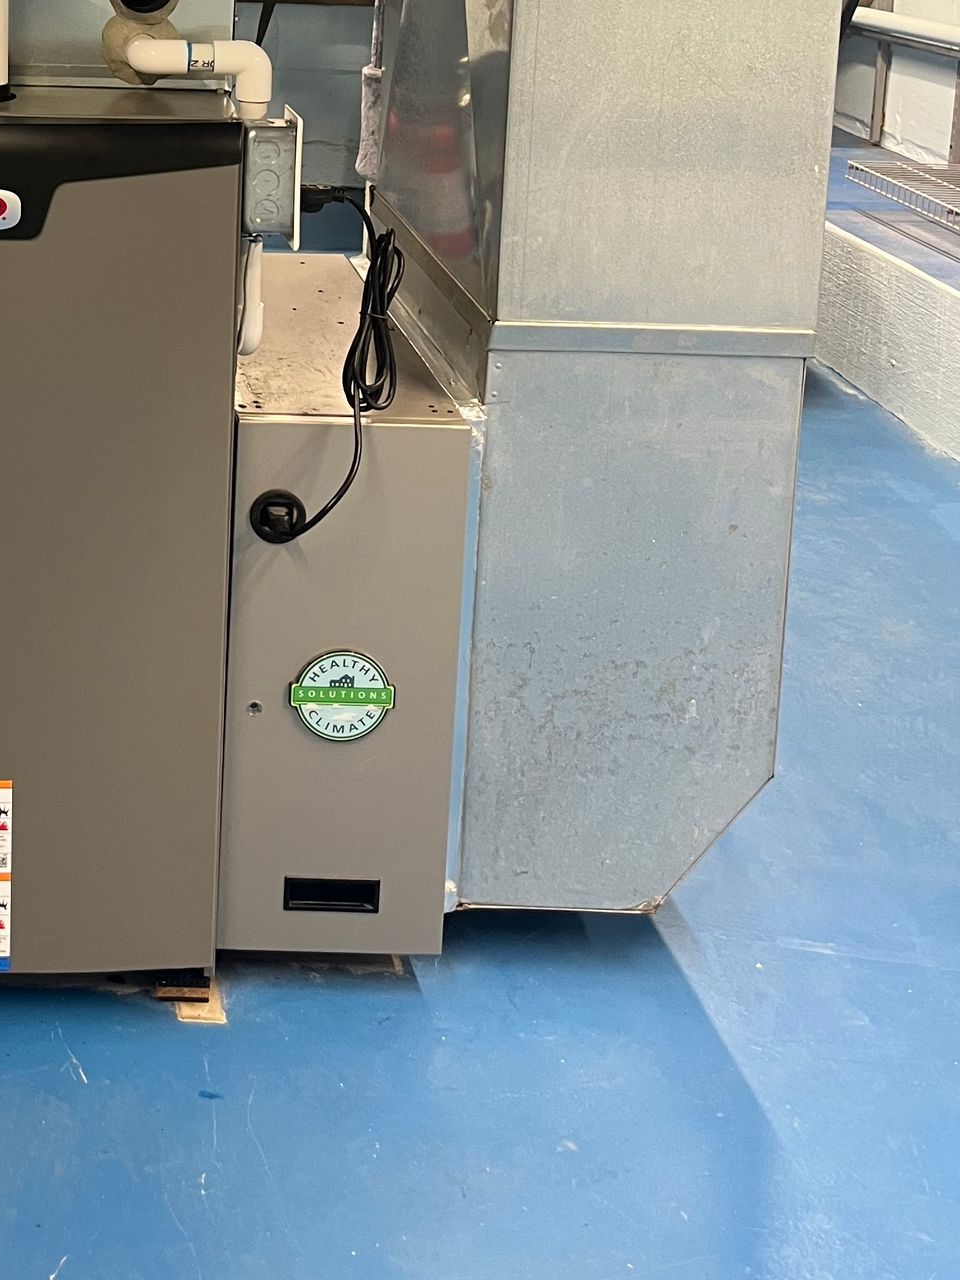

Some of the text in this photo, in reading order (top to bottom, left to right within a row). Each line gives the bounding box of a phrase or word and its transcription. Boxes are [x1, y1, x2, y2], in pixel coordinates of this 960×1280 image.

[309, 658, 380, 683] HEALTHY
[298, 690, 386, 700] SOLUTIONS
[308, 710, 376, 734] CLIMATE
